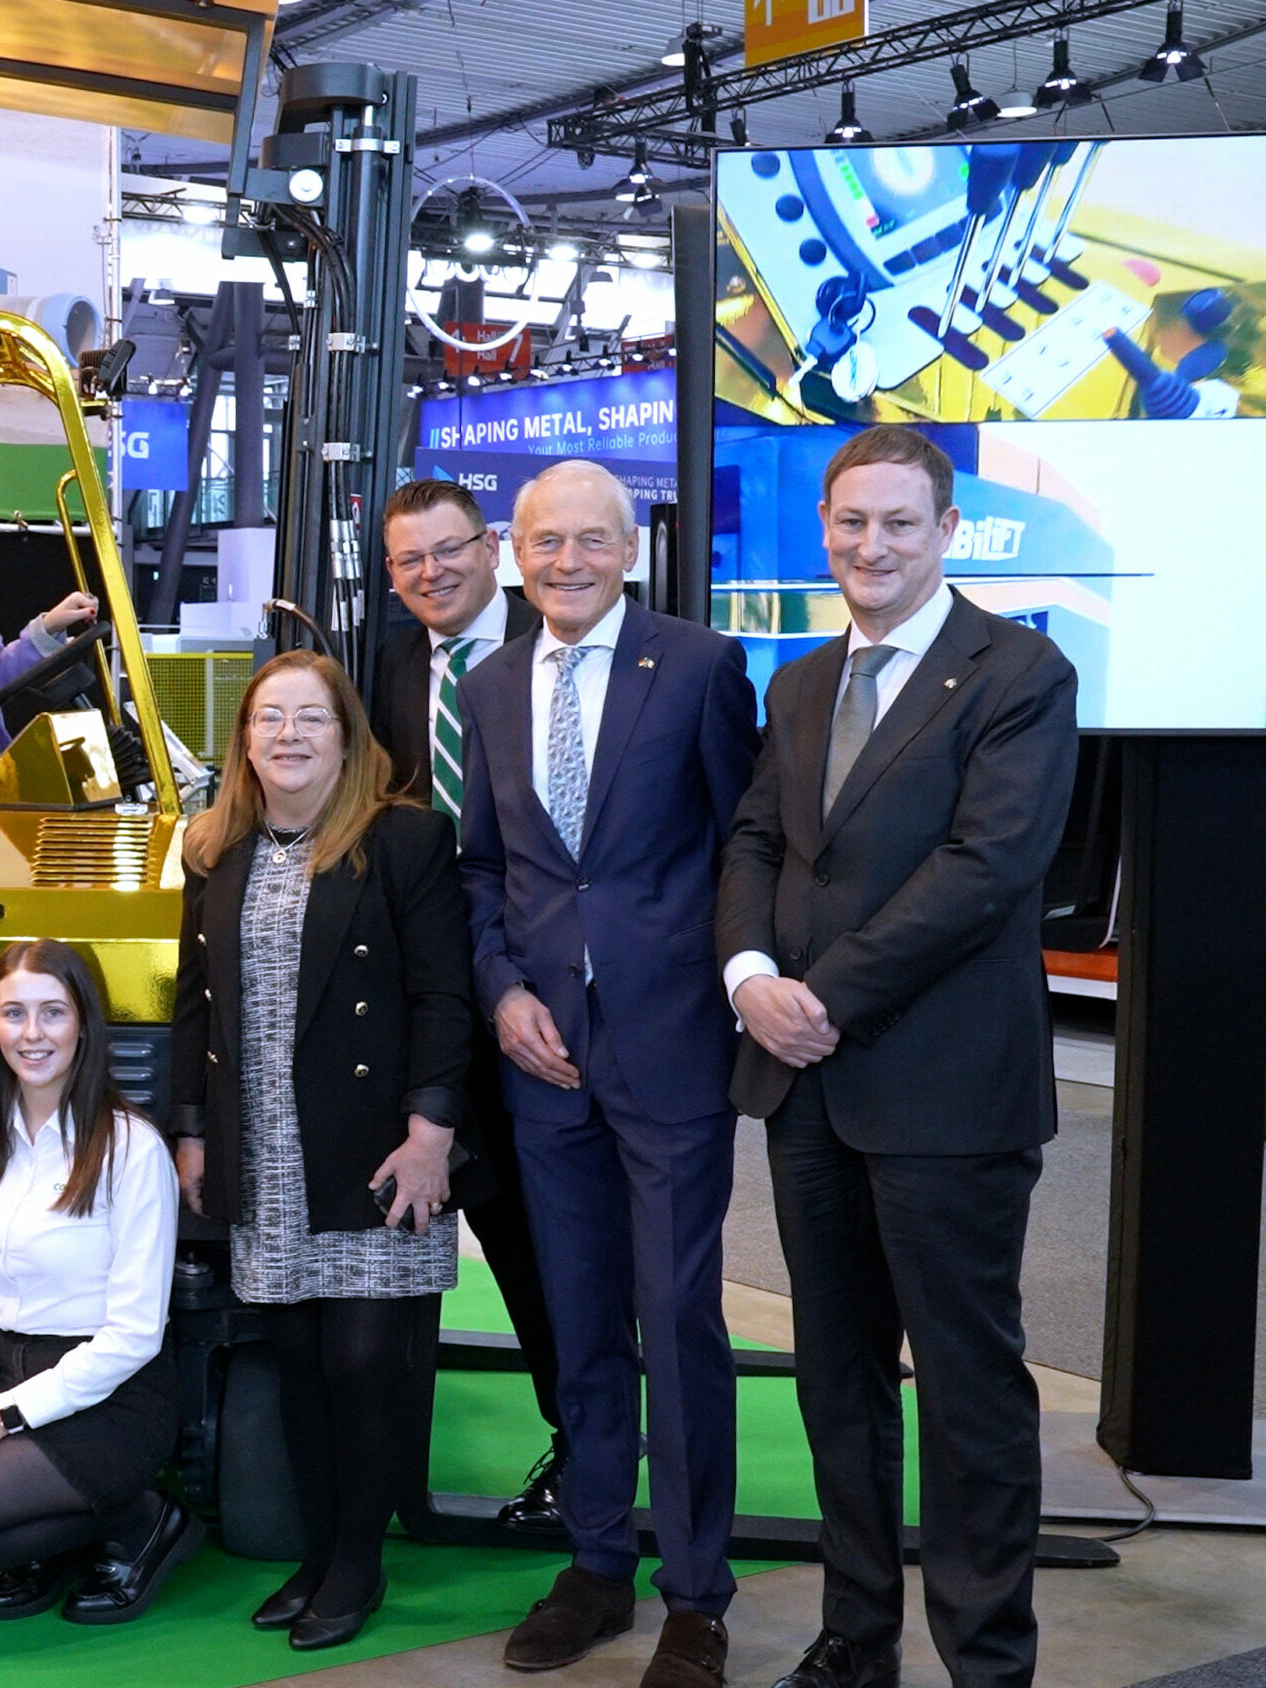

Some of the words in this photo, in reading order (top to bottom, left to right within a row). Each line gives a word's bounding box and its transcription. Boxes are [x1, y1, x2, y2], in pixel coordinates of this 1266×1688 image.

[477, 329, 498, 342] Hall
[524, 411, 593, 439] METAL,
[598, 400, 674, 431] SHAPIN
[528, 444, 553, 455] Your
[556, 440, 584, 455] Most
[588, 434, 634, 452] Reliable
[458, 473, 498, 491] HSG
